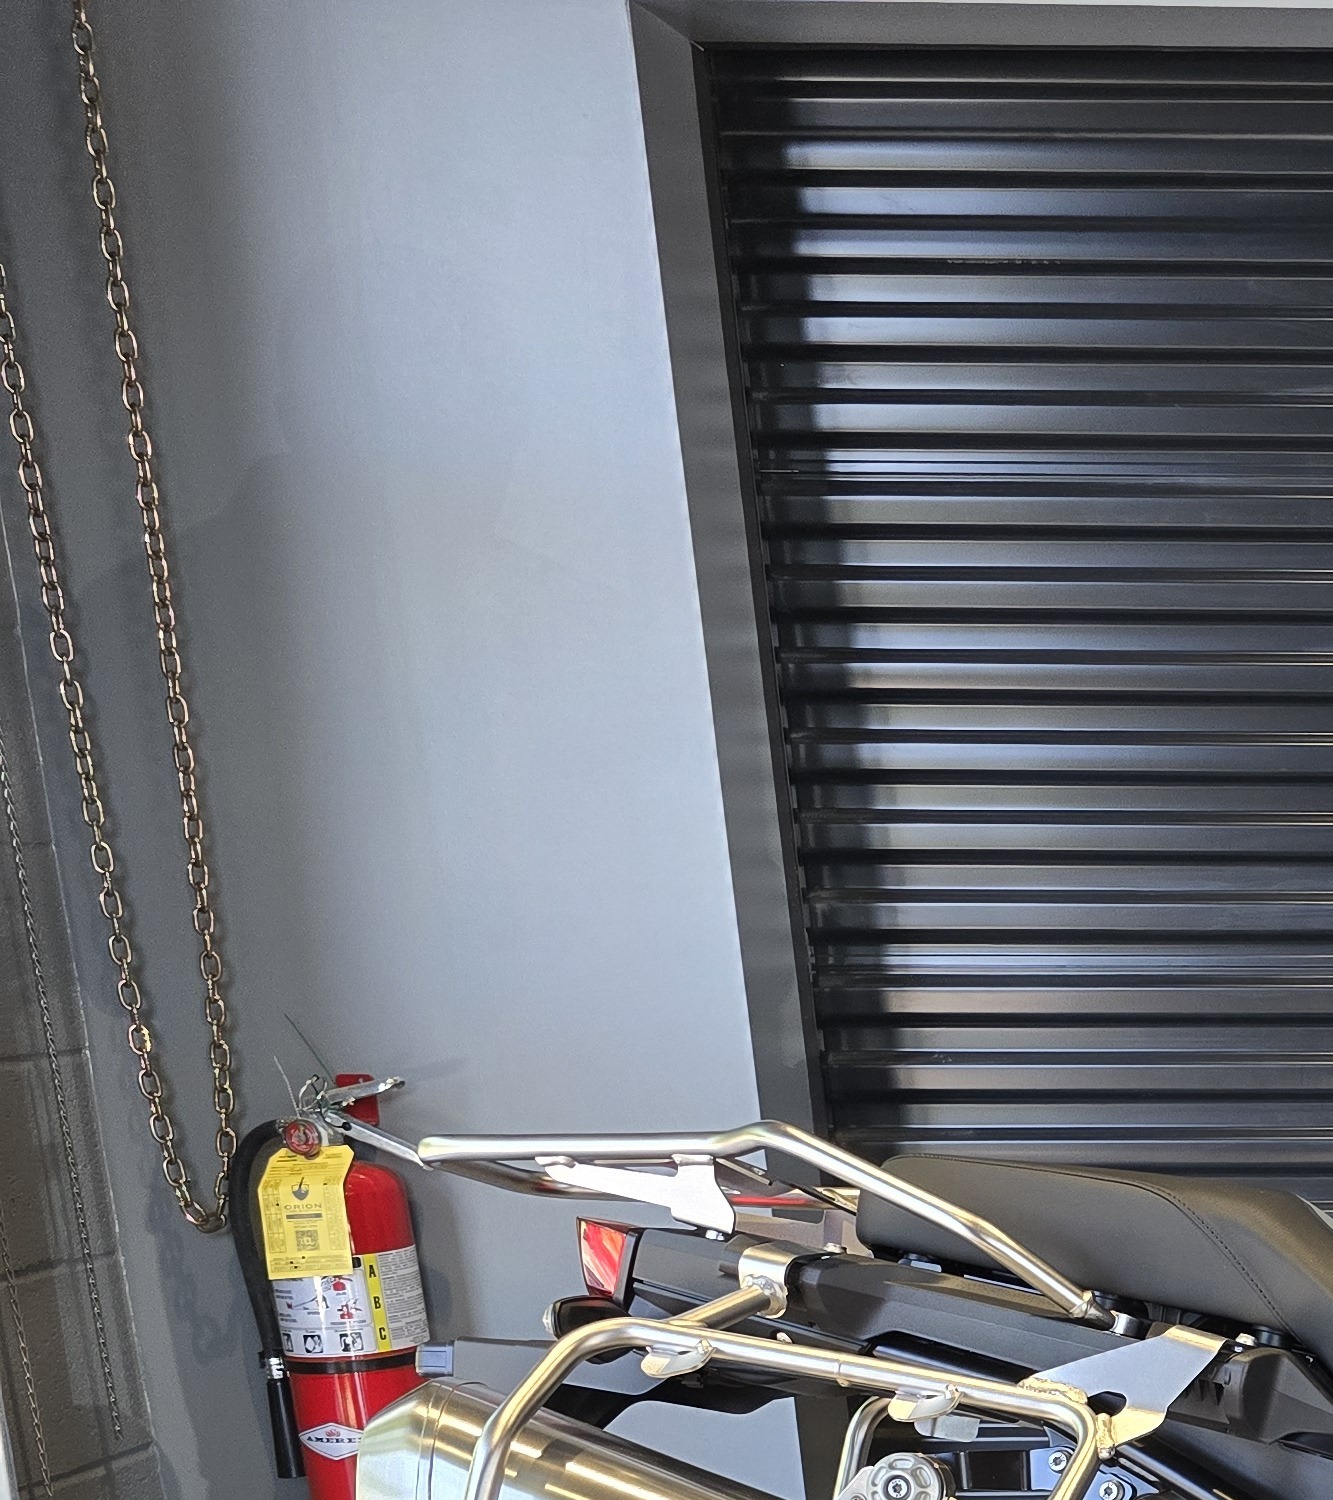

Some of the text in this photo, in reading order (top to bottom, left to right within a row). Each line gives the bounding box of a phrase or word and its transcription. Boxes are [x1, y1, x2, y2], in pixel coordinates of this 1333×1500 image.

[284, 1202, 322, 1211] ORION
[368, 1264, 377, 1278] A
[373, 1295, 382, 1310] B
[379, 1327, 387, 1341] C
